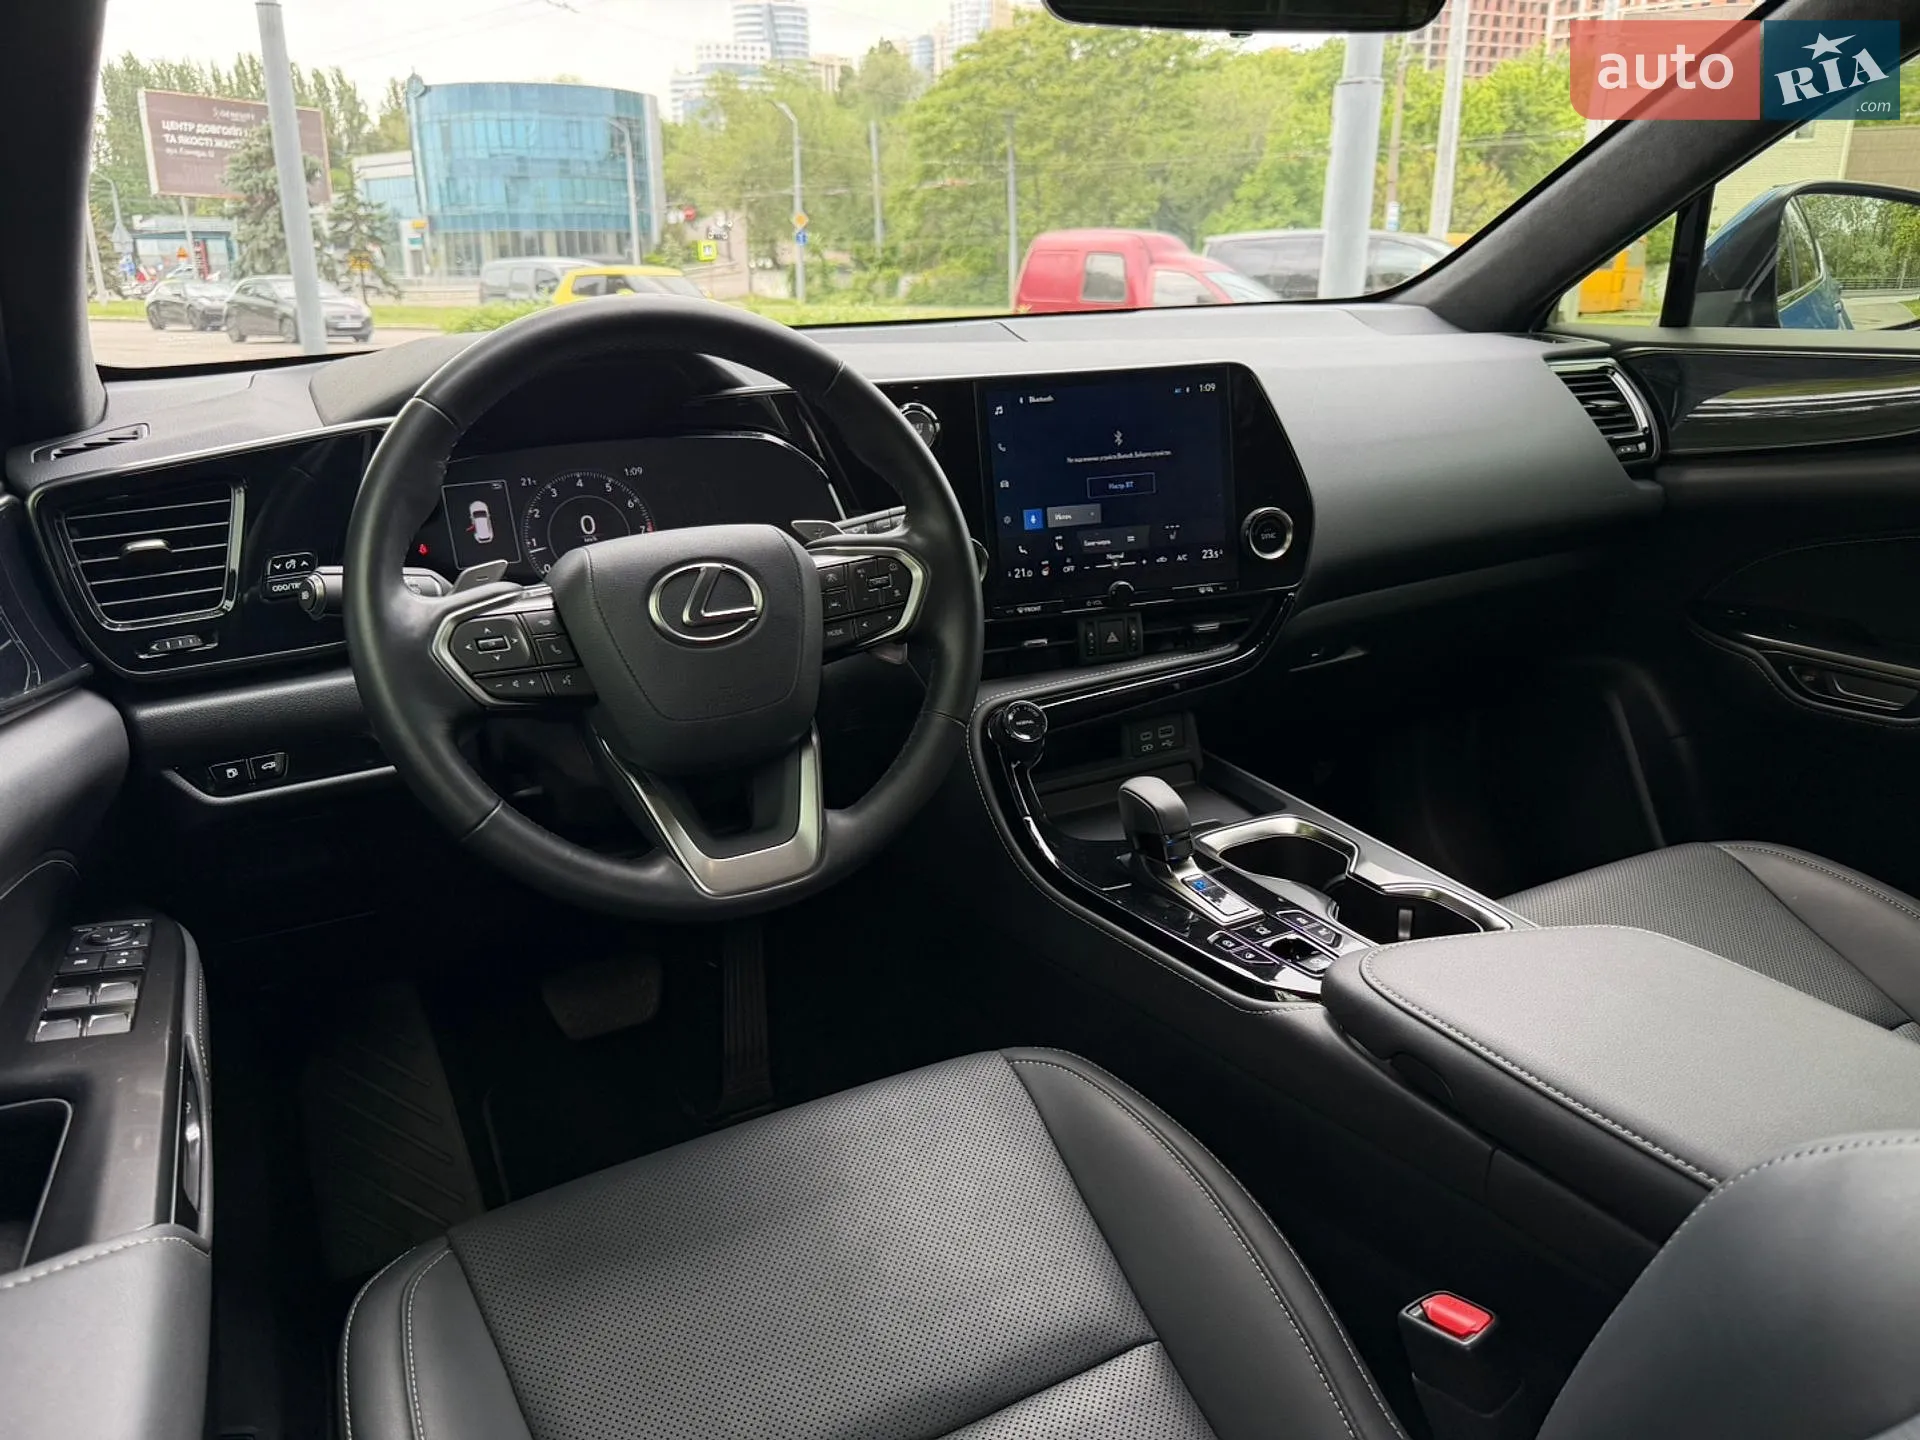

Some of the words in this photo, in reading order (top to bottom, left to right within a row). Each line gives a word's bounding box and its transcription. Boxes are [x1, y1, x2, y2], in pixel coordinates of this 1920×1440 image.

[161, 120, 195, 131] ЦЕНТР
[163, 134, 177, 143] ТА
[178, 135, 213, 147] ЯКОСТІ
[1199, 383, 1216, 393] 1:09
[625, 467, 643, 476] 1:09
[576, 478, 584, 488] 4
[605, 483, 612, 493] 5
[551, 488, 558, 498] 3
[627, 500, 635, 509] 6
[533, 508, 541, 518] 2
[580, 515, 596, 535] 0
